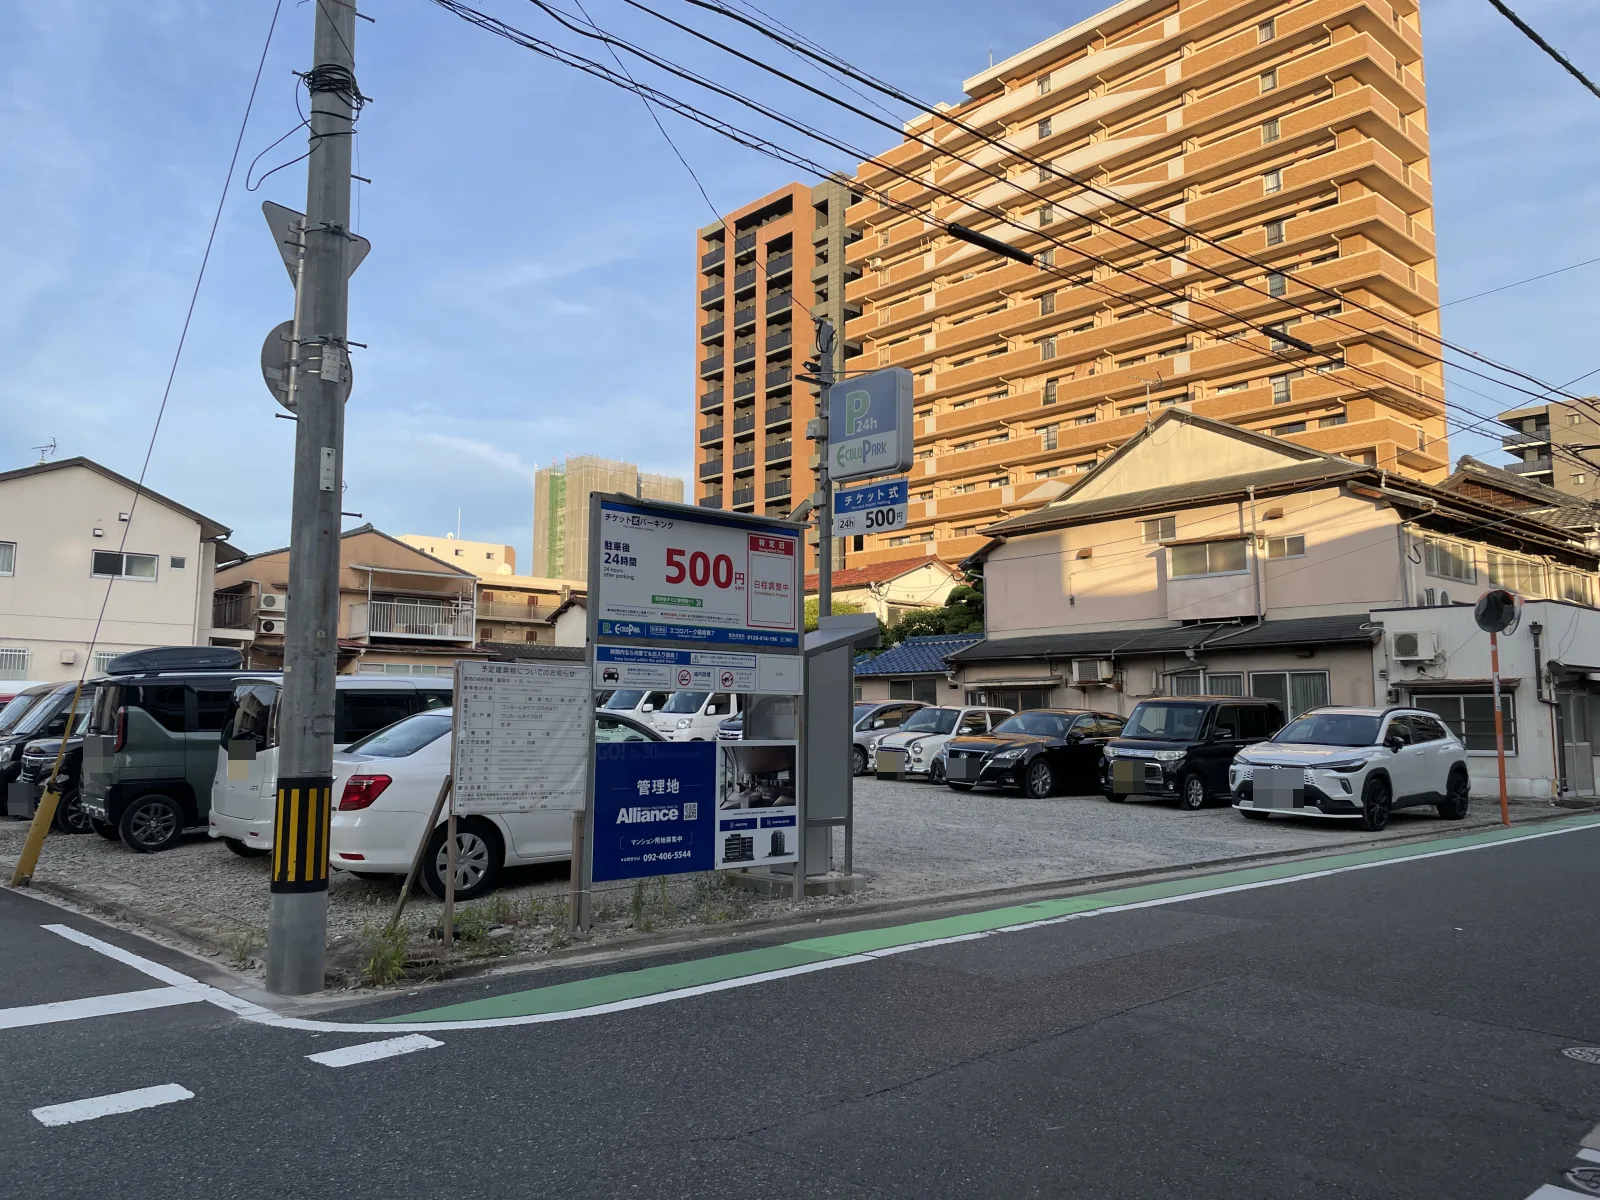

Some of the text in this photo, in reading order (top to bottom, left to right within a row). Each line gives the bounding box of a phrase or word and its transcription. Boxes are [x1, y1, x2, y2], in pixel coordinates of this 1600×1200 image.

[845, 389, 871, 437] P
[856, 416, 878, 433] 24h
[845, 486, 900, 506] チケット式
[839, 518, 854, 529] 24h
[604, 541, 630, 552] 駐車後
[759, 539, 785, 550] 特定日
[603, 553, 637, 567] 24時間
[754, 580, 790, 592] 日程調整中
[481, 665, 576, 678] 予定建築物についてのお知らせ
[637, 778, 680, 796] 管理地
[616, 807, 679, 824] Alliance
[631, 835, 683, 846] マンション用地募集中
[642, 850, 692, 862] 092-406-5544
